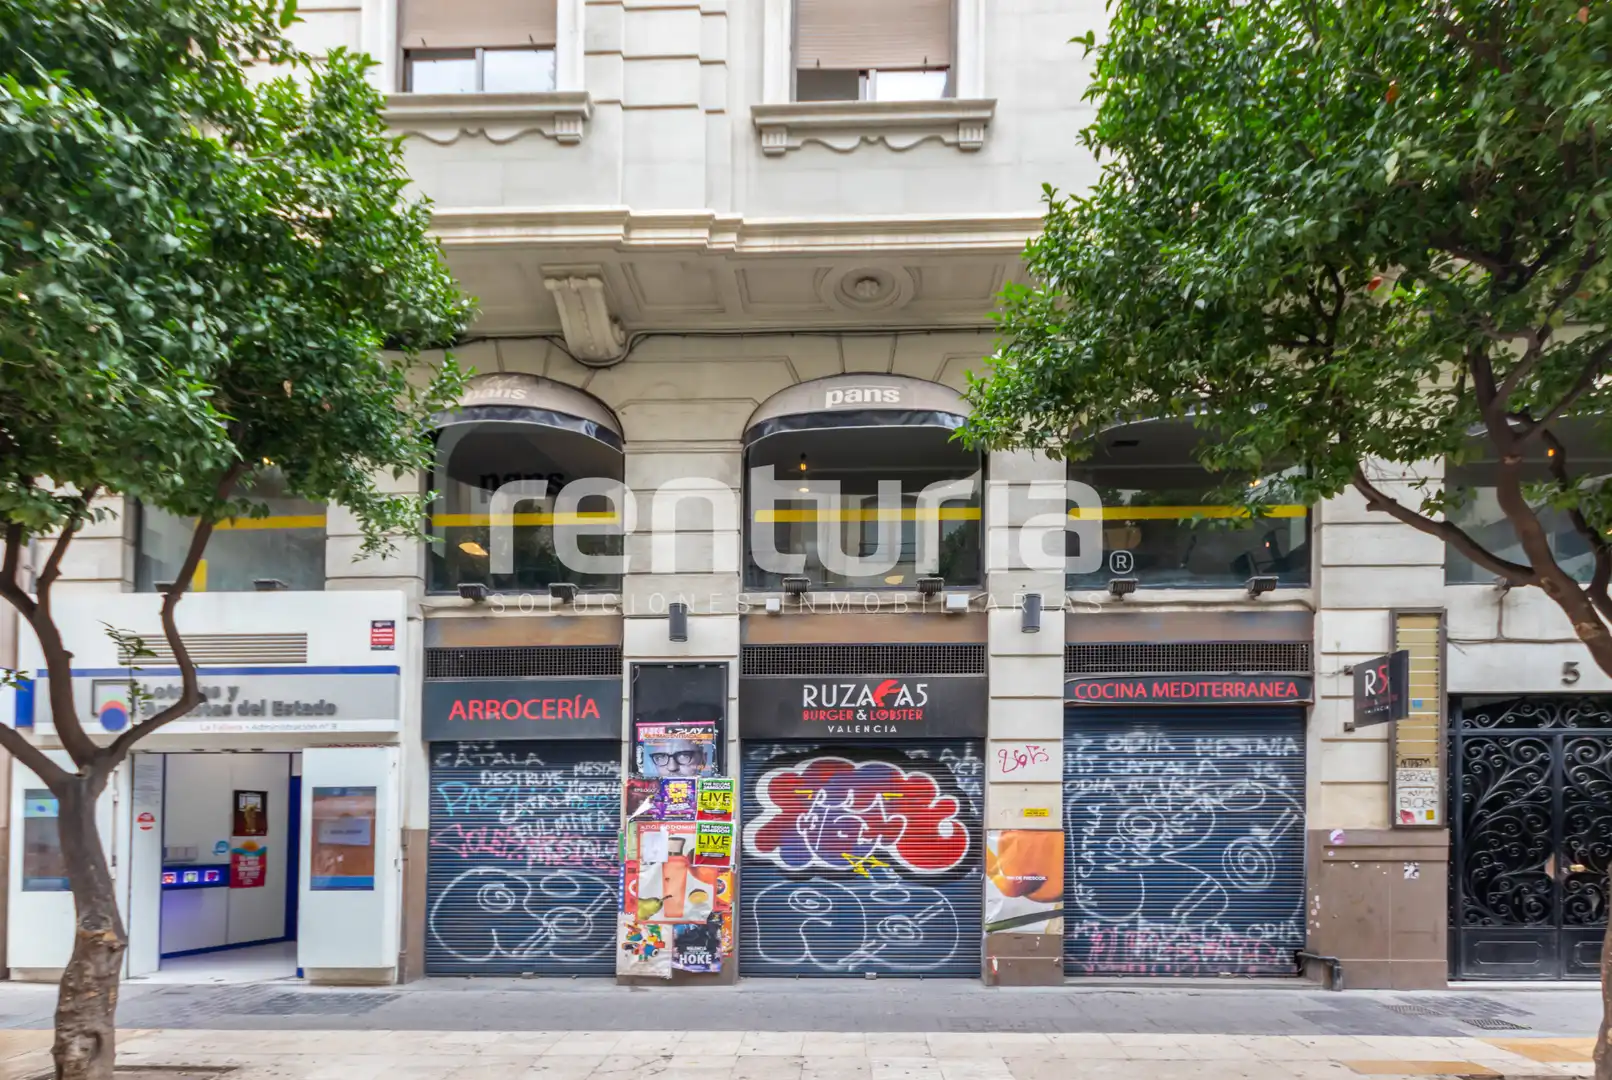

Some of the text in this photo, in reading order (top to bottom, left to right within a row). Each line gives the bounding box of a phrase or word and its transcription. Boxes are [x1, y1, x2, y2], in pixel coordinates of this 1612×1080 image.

[825, 387, 900, 409] pans
[1561, 661, 1581, 686] 5
[227, 685, 240, 702] y
[1075, 681, 1299, 699] COCINA MEDITERRANEA
[237, 699, 267, 717] del
[271, 699, 337, 717] Estado
[448, 693, 601, 721] ARROCERÍA
[803, 709, 924, 721] BURGER & LOBSTER
[828, 724, 898, 734] VALENCIA
[700, 792, 731, 802] LIVE
[698, 834, 730, 845] LIVE
[679, 953, 712, 965] HOKE
